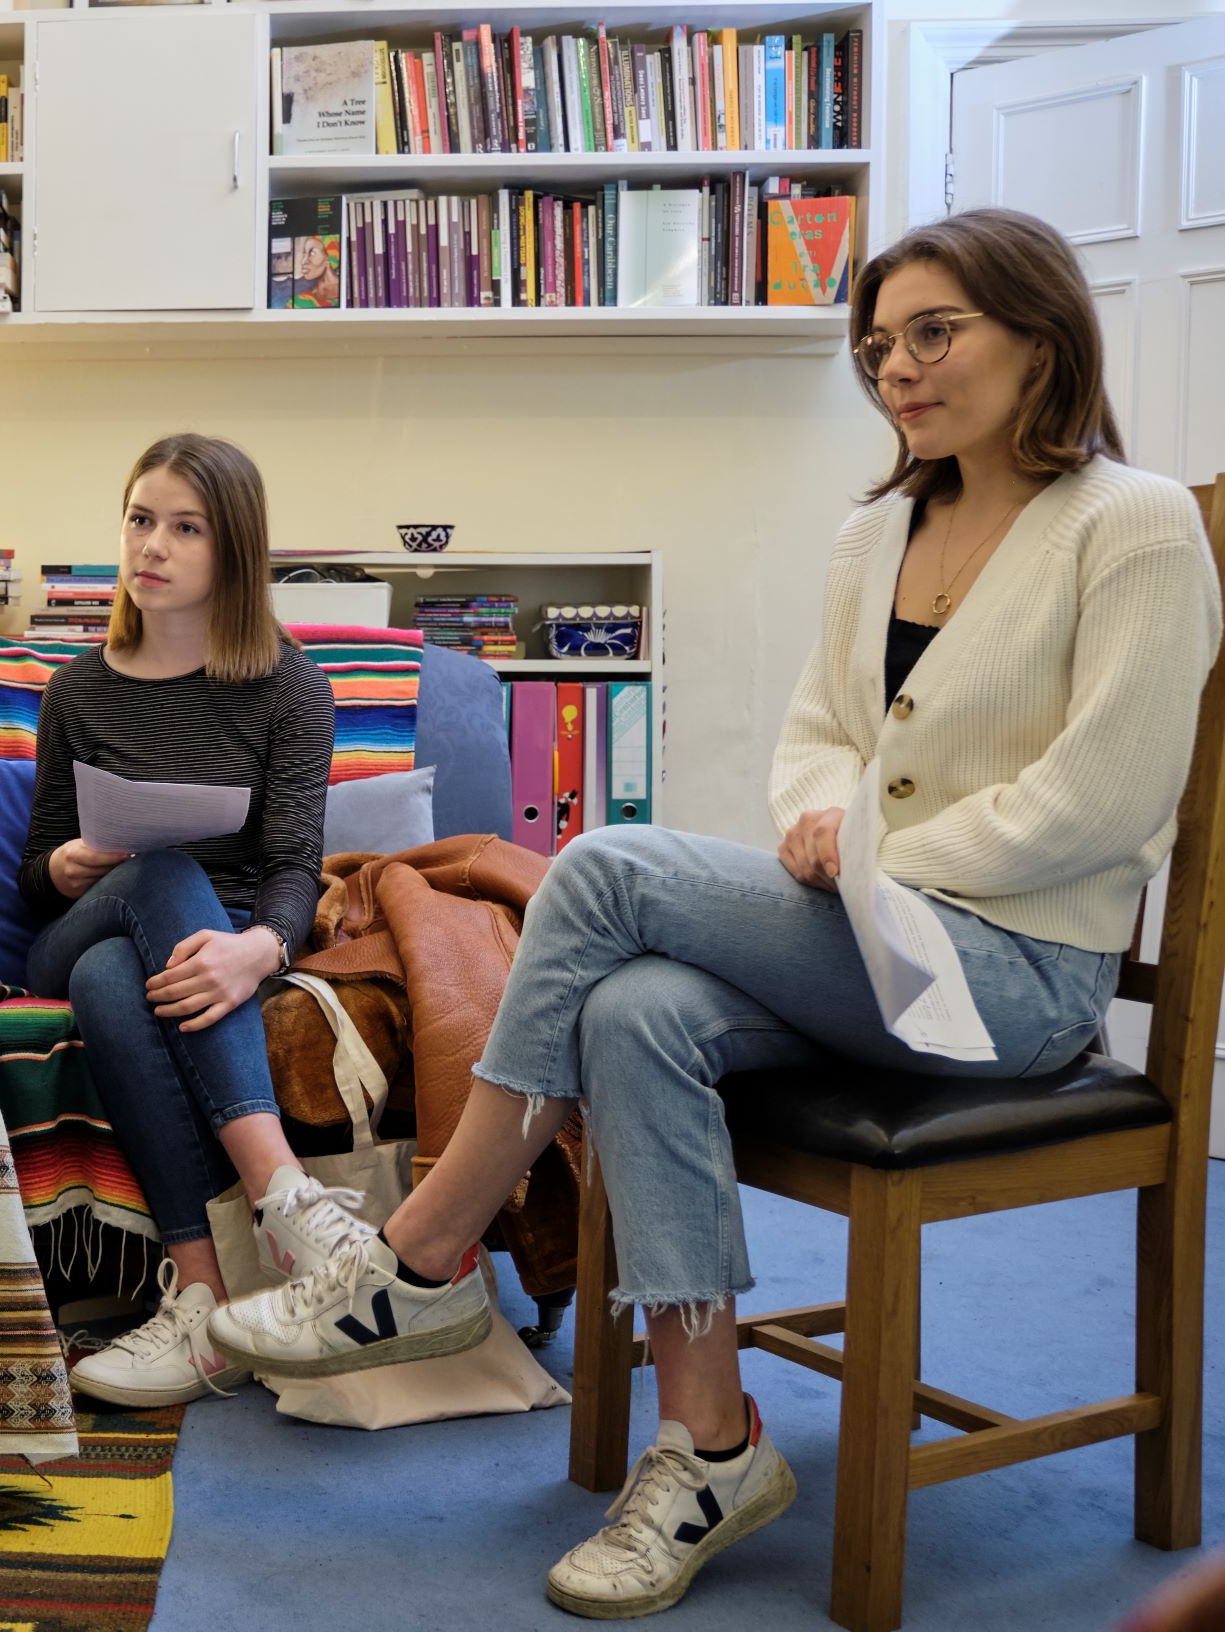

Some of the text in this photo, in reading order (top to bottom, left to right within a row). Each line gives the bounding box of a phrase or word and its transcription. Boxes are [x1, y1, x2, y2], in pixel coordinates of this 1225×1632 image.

[621, 50, 633, 106] ILLUMINATIONS
[350, 98, 366, 106] Tree
[318, 110, 342, 118] Whose
[322, 120, 342, 128] Don't
[606, 213, 616, 289] Our Caribbean
